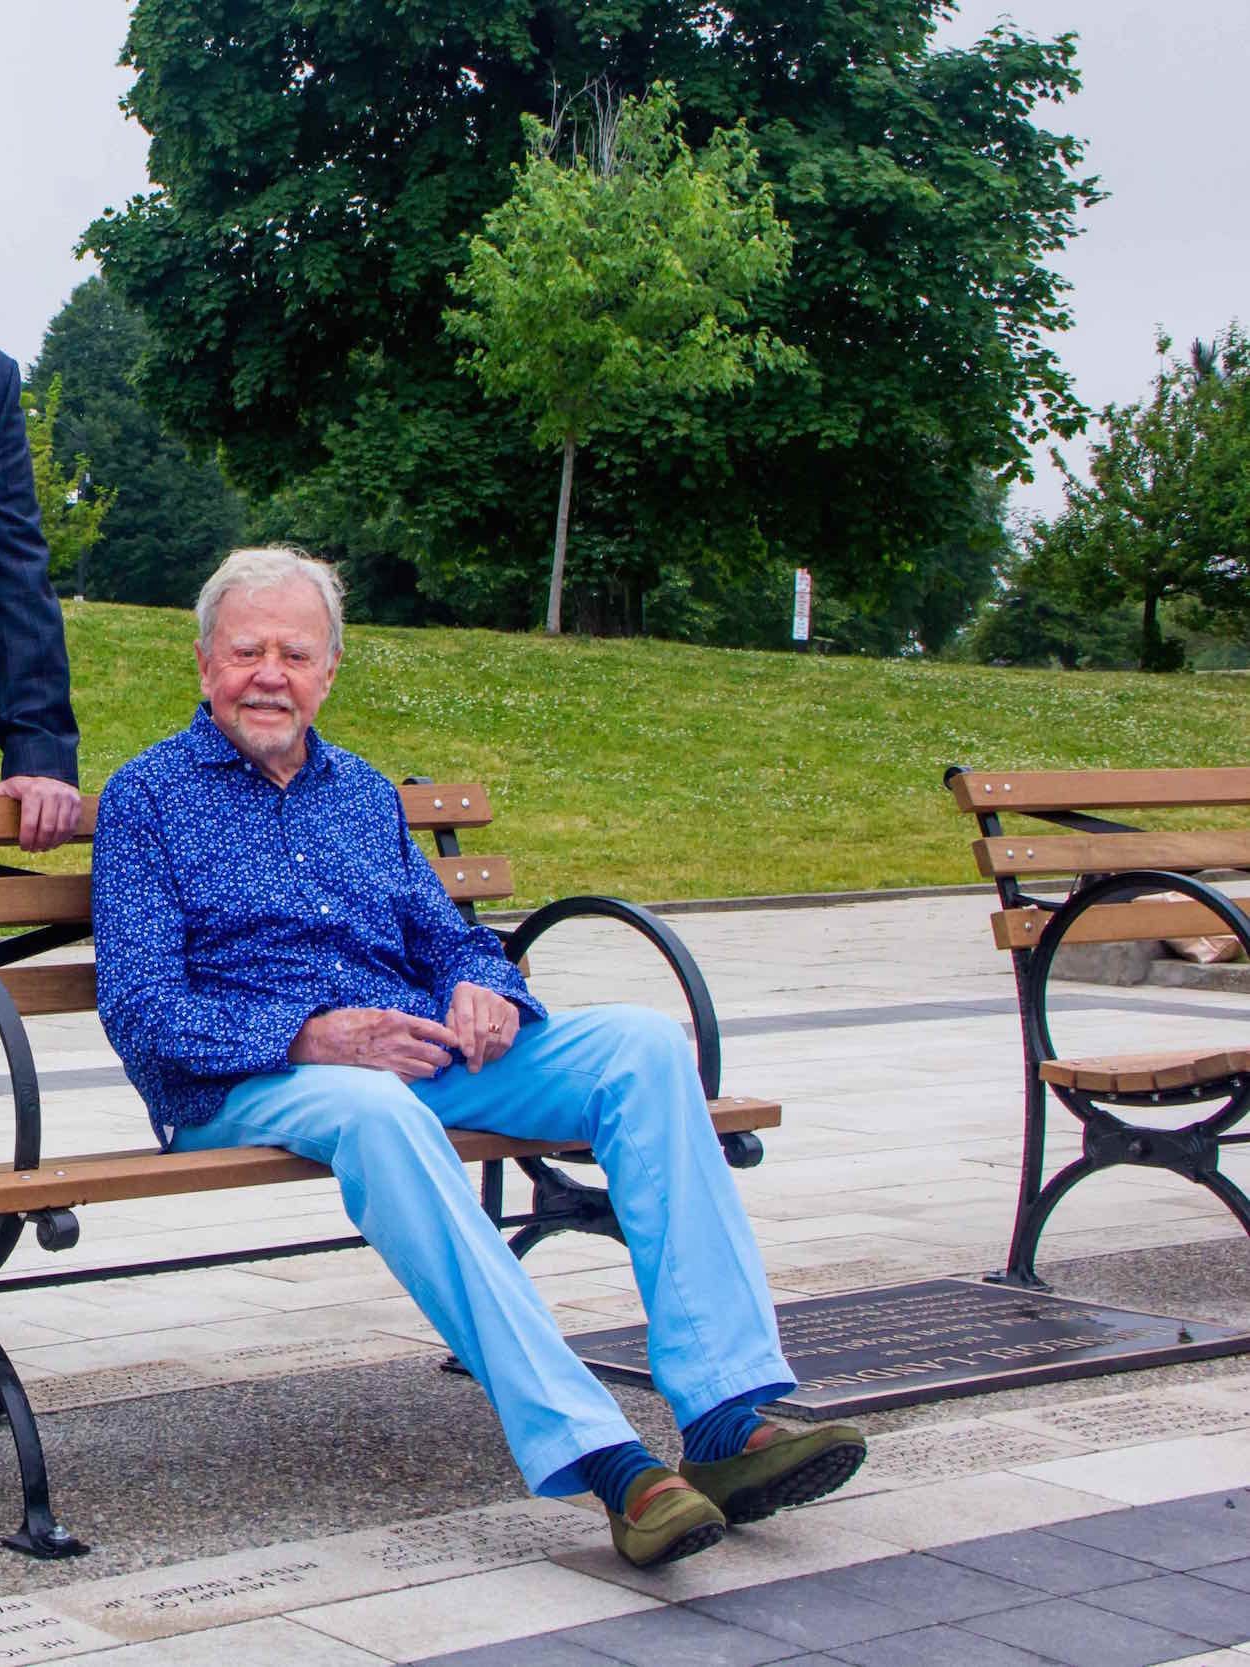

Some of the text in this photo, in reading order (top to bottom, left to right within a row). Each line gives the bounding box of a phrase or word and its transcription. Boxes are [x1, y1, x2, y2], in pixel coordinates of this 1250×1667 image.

[260, 1561, 319, 1579] PETER
[186, 1581, 278, 1605] MEMORY
[149, 1601, 181, 1612] OF
